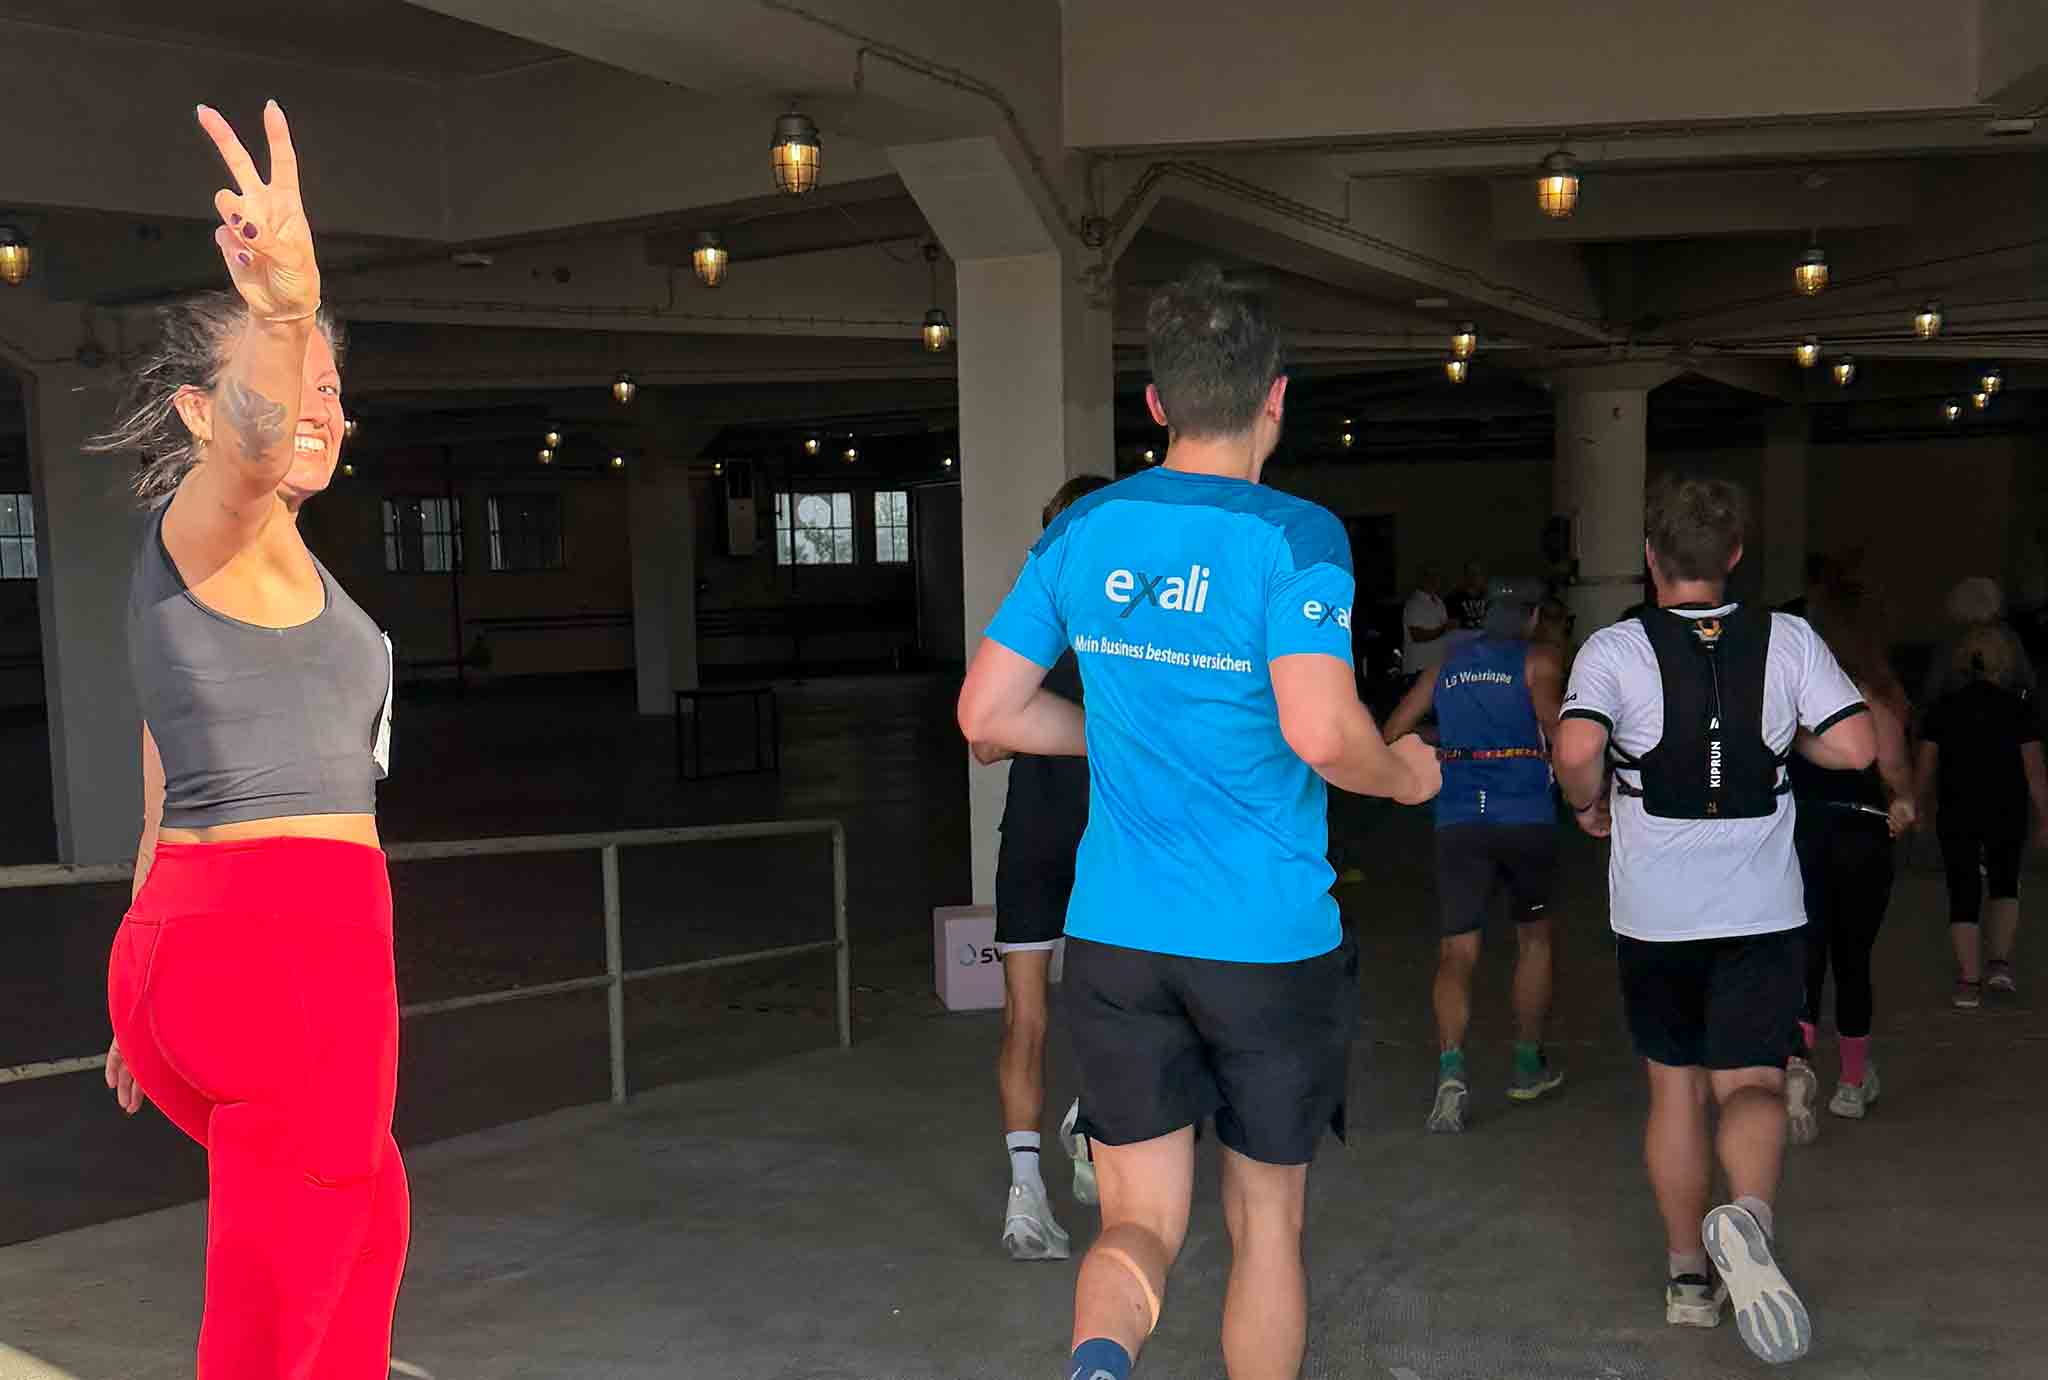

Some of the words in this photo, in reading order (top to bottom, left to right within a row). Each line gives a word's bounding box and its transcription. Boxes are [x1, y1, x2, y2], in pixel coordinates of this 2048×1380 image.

[1104, 564, 1210, 618] exali
[1303, 600, 1351, 629] exa
[1101, 636, 1145, 659] Business
[1145, 641, 1190, 666] bestens
[1709, 741, 1721, 788] KIPRUN
